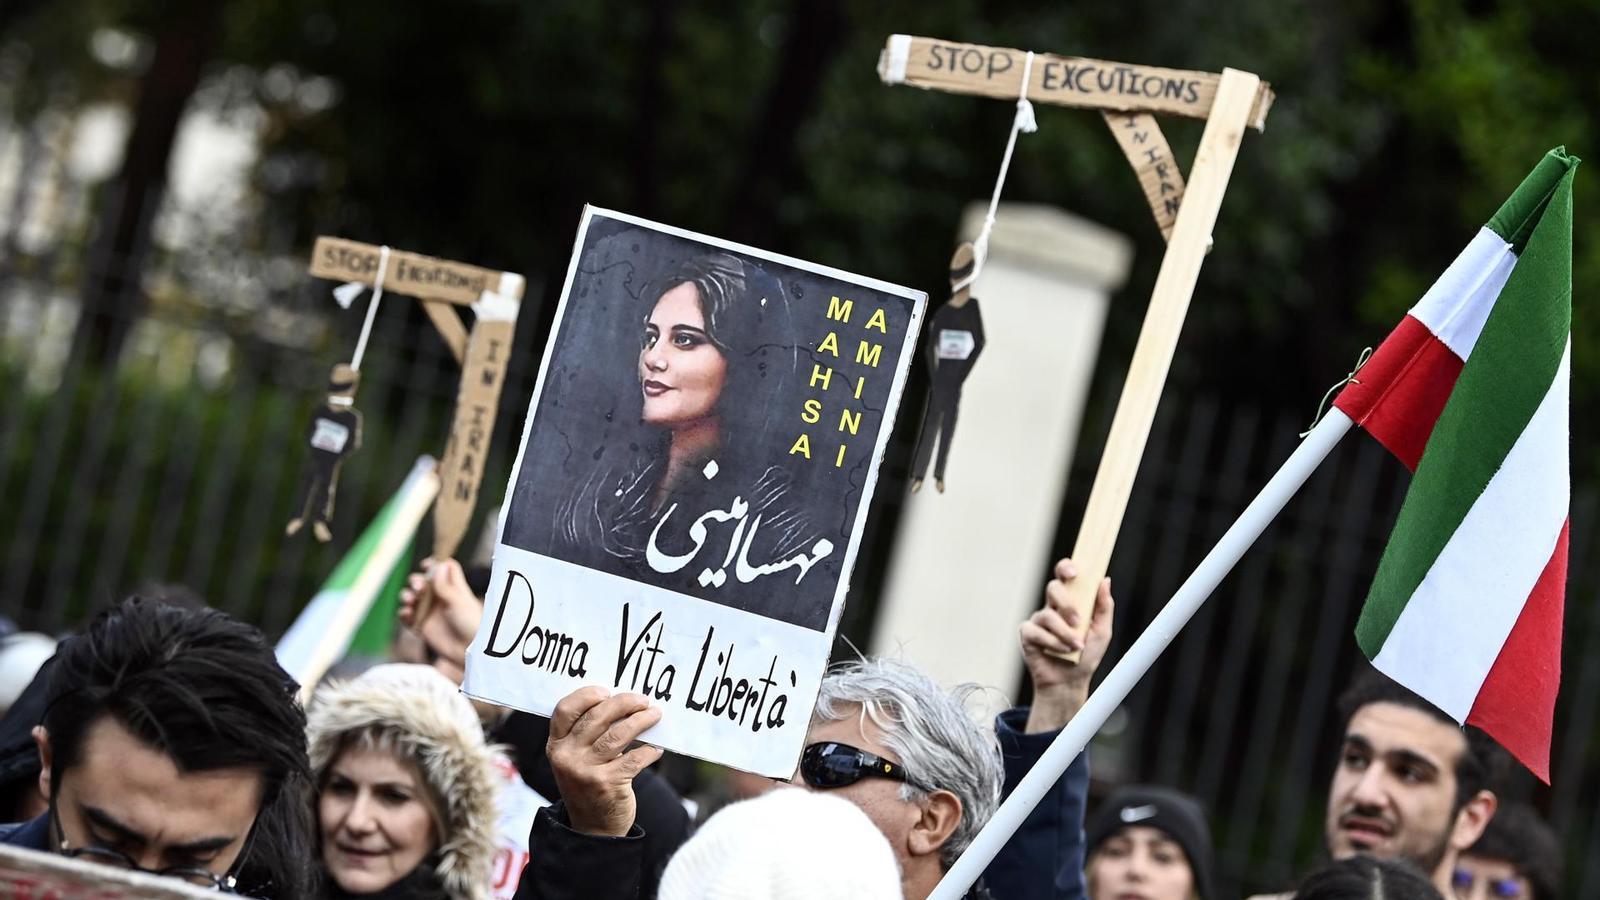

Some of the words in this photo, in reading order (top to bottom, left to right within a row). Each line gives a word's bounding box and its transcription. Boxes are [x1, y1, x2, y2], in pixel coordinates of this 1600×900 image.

[927, 45, 1012, 79] STOP
[1042, 62, 1200, 104] EXCUTIONS
[1124, 115, 1149, 144] IN
[1143, 146, 1180, 217] IRAN
[324, 246, 379, 273] STOP
[481, 338, 500, 385] IN
[789, 296, 853, 459] MAHSA
[835, 308, 887, 467] AMINI
[455, 405, 485, 500] IRAN
[646, 460, 749, 588] امینی
[735, 513, 834, 585] مهسا
[484, 569, 589, 679] Donna
[614, 602, 676, 702] Vita
[685, 625, 797, 733] Libertà
